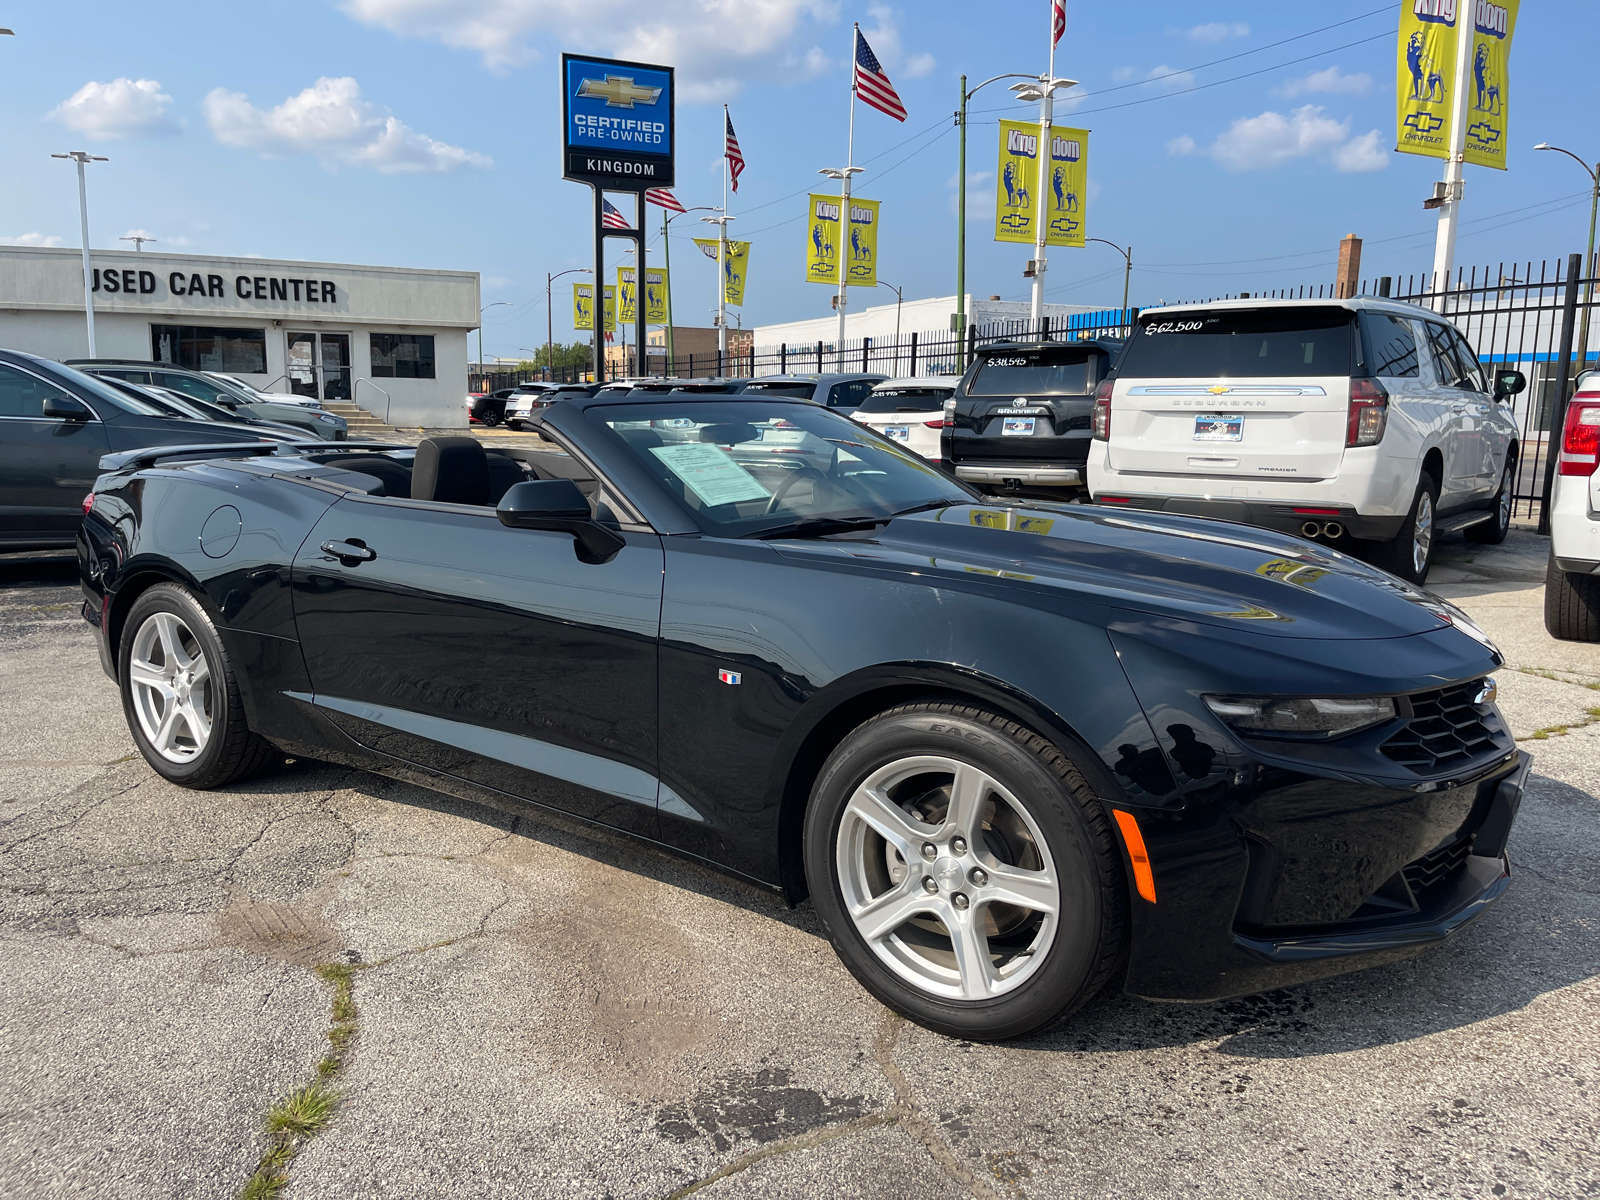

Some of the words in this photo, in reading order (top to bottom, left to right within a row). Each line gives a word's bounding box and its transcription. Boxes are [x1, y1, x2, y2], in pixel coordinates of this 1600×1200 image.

[1475, 0, 1508, 40] dom
[574, 114, 665, 133] CERTIFIED
[578, 126, 662, 144] PRE-OWNED
[1007, 129, 1037, 158] King
[1405, 133, 1444, 144] CHEVROLET
[1052, 136, 1080, 162] dom
[1466, 142, 1501, 155] CHEVROLET
[587, 158, 655, 176] KINGDOM
[816, 200, 839, 222] King
[850, 205, 873, 225] dom
[1000, 227, 1031, 235] CHEVROLET
[169, 271, 225, 298] CAR
[235, 274, 337, 304] CENTER
[604, 289, 613, 299] om
[1145, 321, 1203, 336] $62,500
[928, 723, 1019, 763] EAGLE
